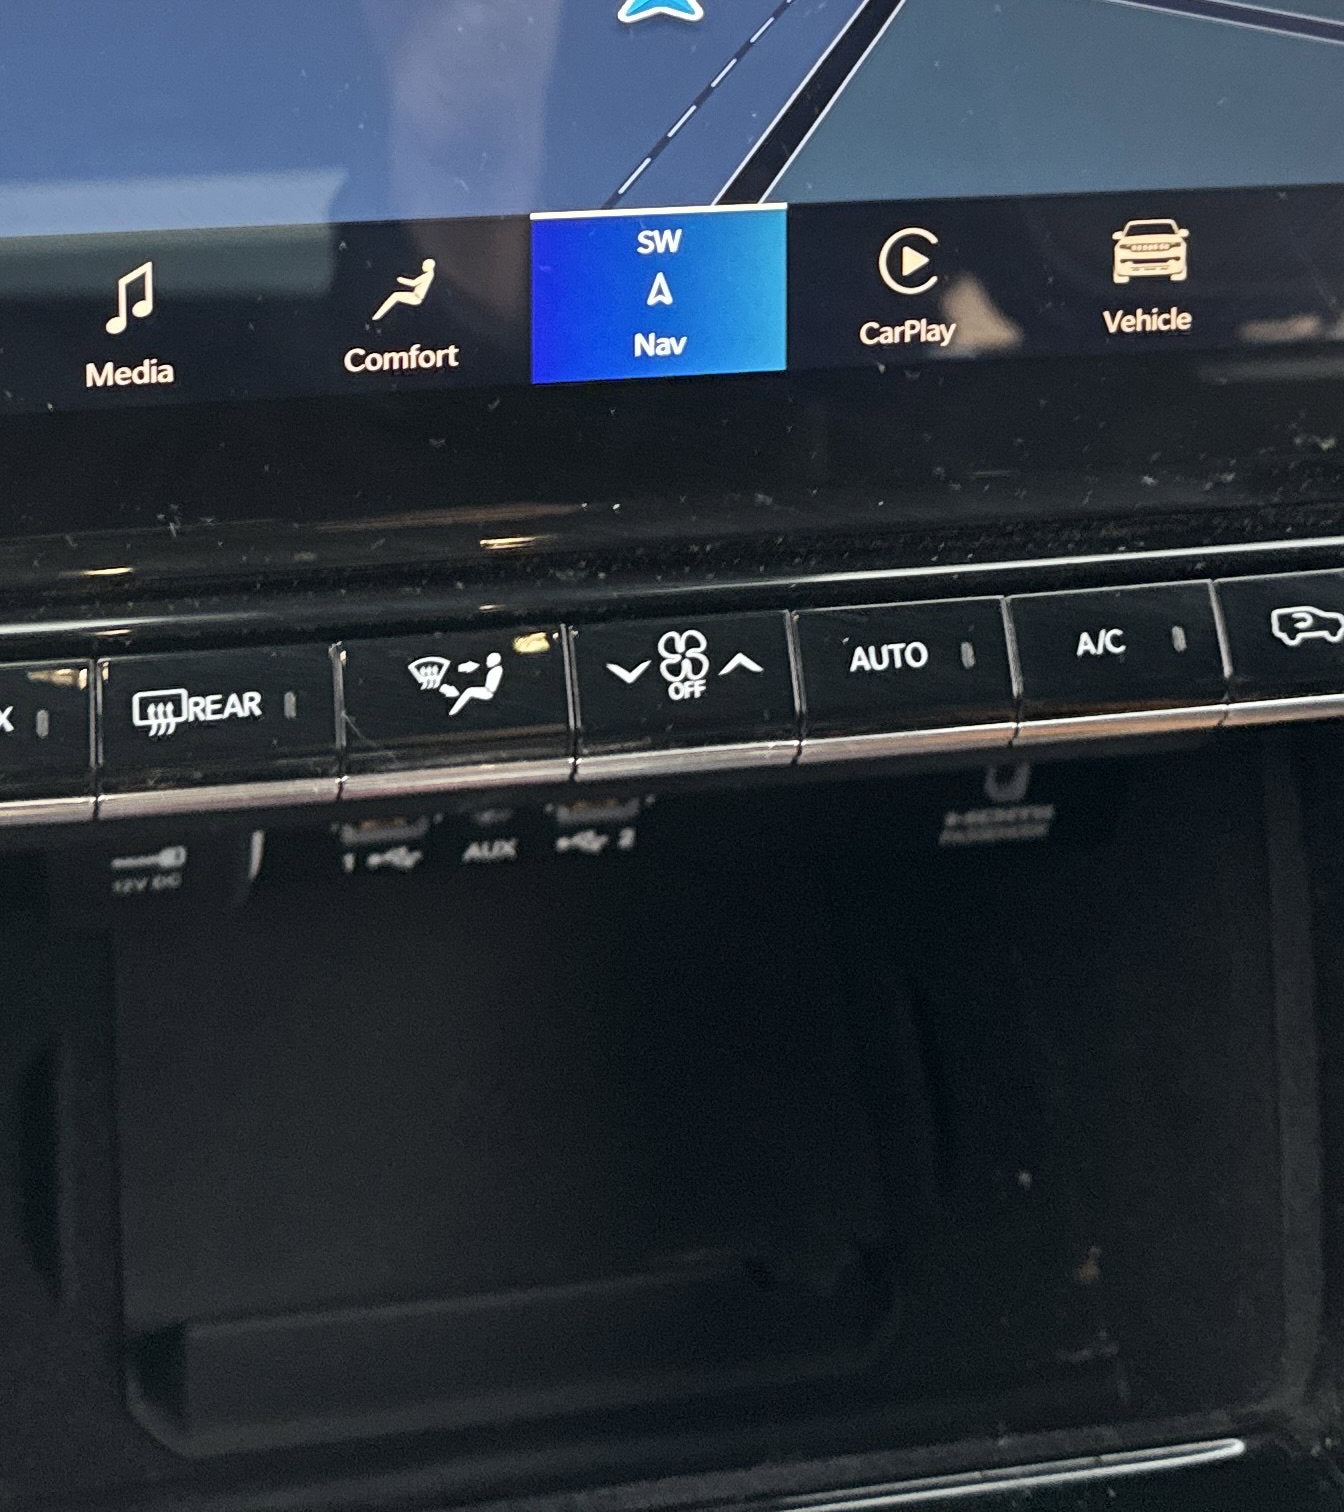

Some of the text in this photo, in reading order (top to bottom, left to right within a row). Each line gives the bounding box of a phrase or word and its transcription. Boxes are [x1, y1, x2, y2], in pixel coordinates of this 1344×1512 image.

[636, 228, 683, 254] SW
[859, 319, 957, 348] CarPlay
[1103, 306, 1193, 335] Vehicle
[343, 343, 460, 373] Comfort
[633, 332, 687, 357] Nav
[85, 358, 175, 388] Media
[849, 641, 929, 672] AUTO
[1076, 628, 1127, 657] A/C
[667, 678, 707, 701] OFF
[187, 691, 263, 722] REAR
[462, 838, 518, 864] AUX
